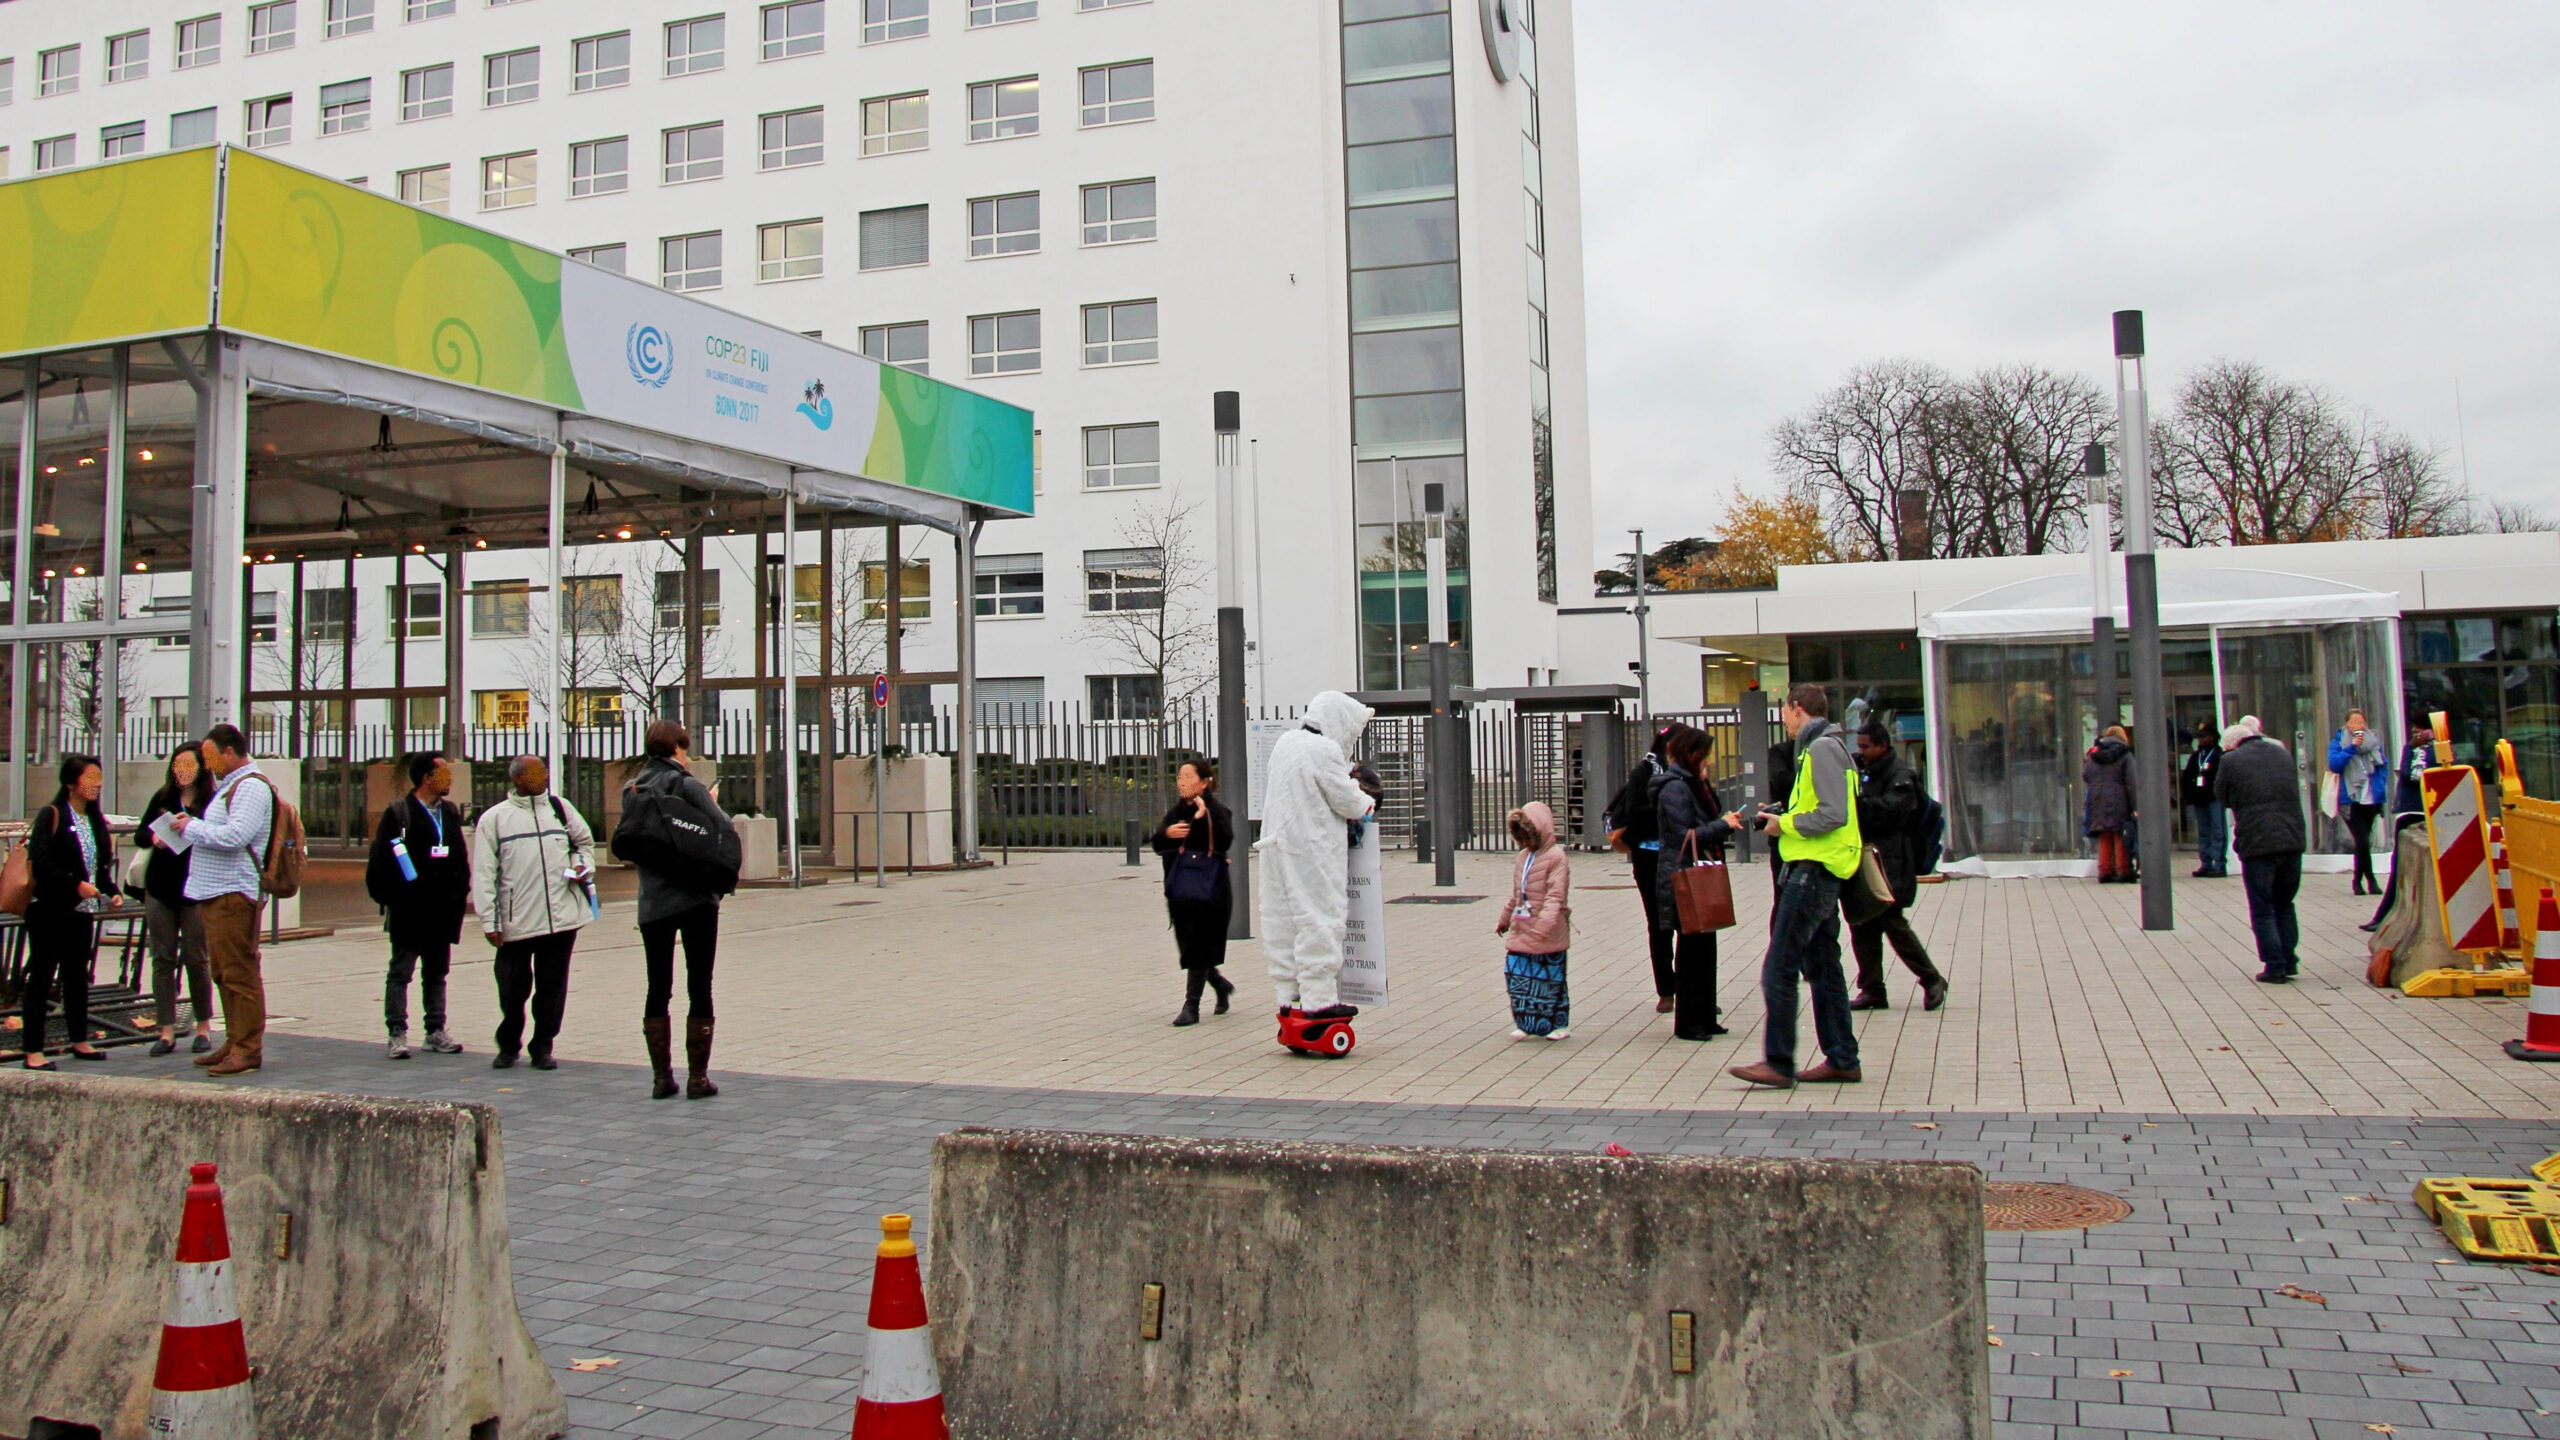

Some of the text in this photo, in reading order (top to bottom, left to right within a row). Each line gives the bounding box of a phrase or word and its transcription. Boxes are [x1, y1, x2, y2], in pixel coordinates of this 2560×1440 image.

[705, 335, 769, 372] COP23 FIJI
[715, 394, 759, 424] BONN 2017
[1351, 876, 1371, 886] BAHN
[1346, 945, 1355, 955] BY
[1343, 959, 1377, 970] ND TRAIN
